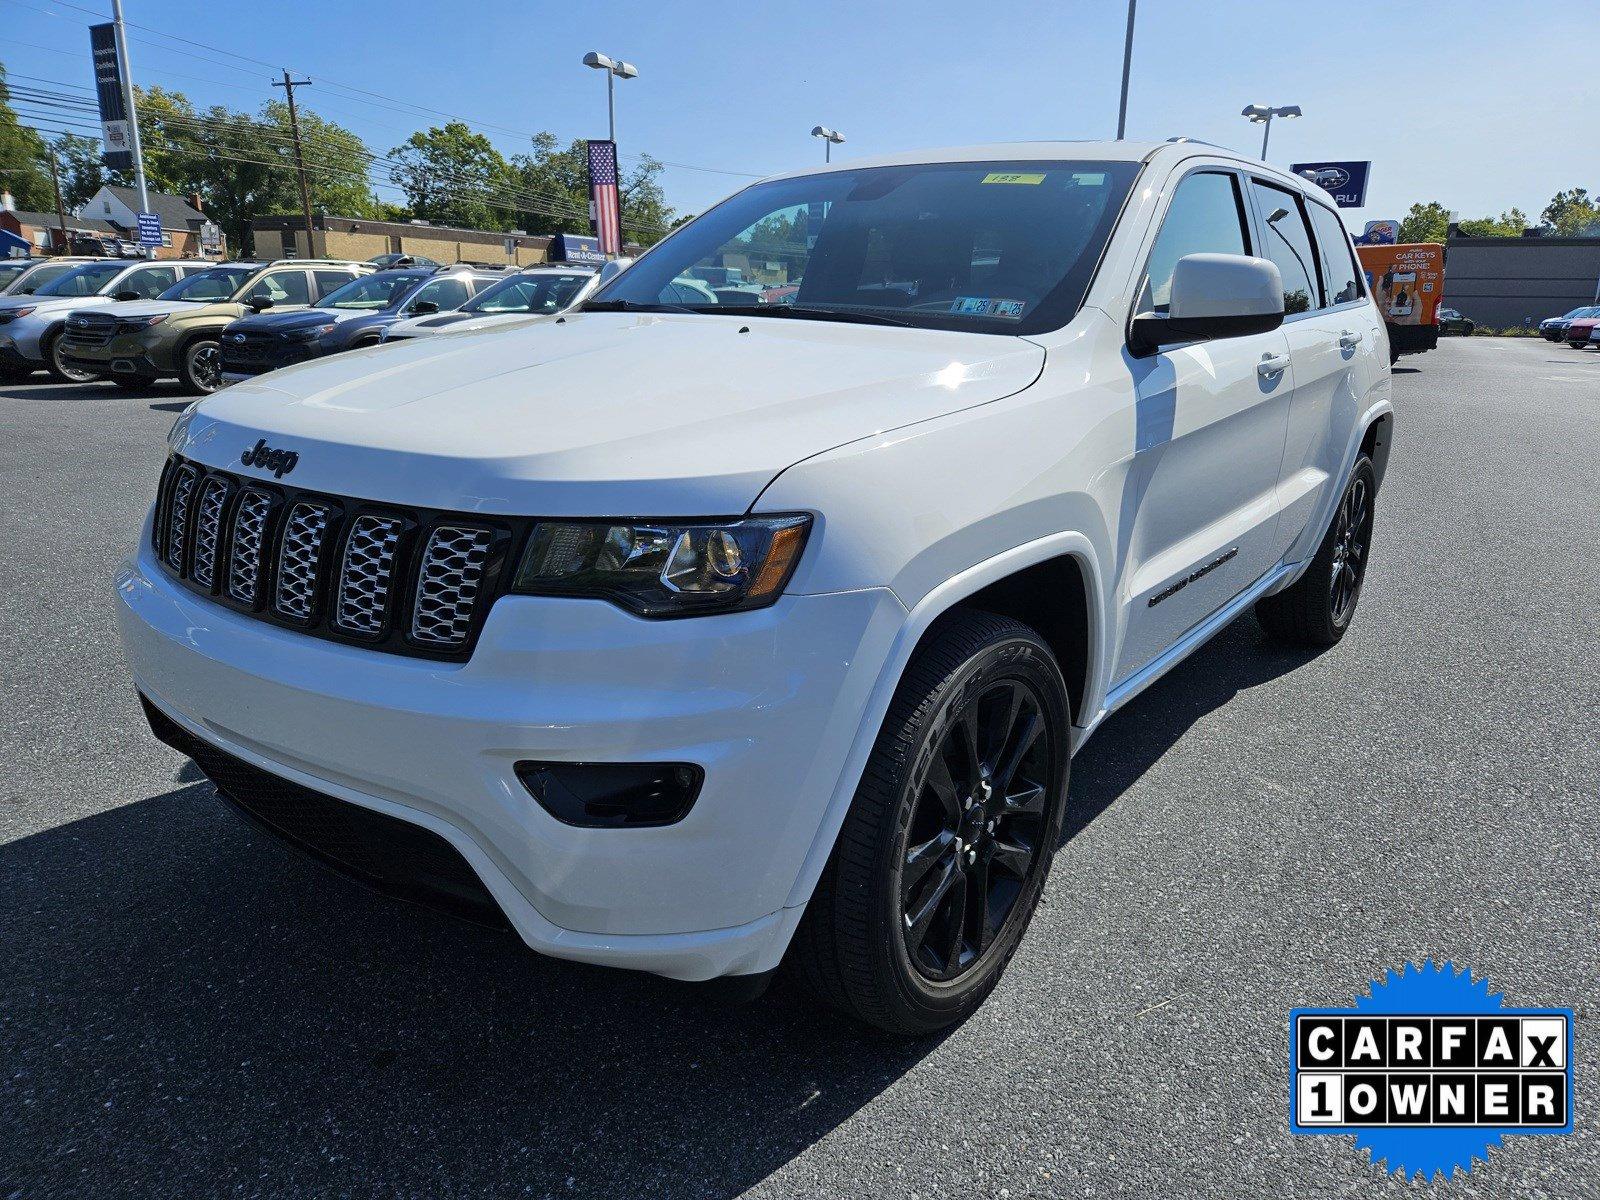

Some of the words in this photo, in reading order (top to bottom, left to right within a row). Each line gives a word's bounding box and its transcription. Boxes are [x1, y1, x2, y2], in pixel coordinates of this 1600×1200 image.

[1336, 194, 1357, 203] RU
[1395, 252, 1413, 260] CAR
[1414, 251, 1436, 259] KEYS
[240, 438, 300, 479] Jeep
